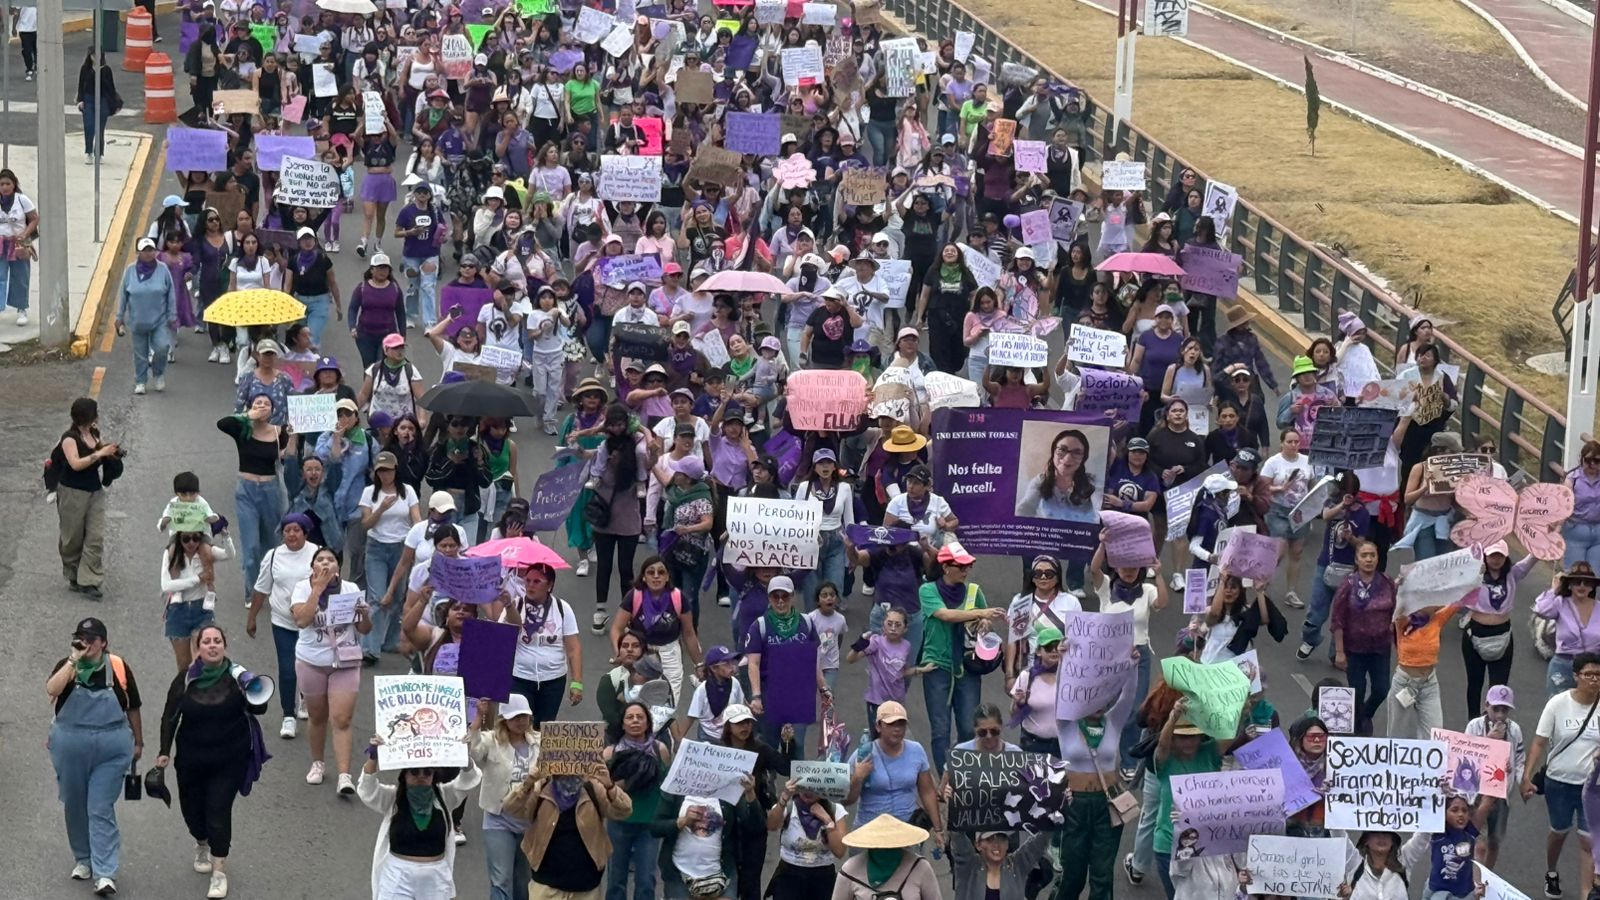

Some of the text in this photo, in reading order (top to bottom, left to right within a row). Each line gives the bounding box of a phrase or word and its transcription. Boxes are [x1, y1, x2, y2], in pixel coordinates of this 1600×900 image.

[952, 431, 987, 440] ESTAMOS
[948, 462, 1002, 476] Nos falta
[733, 502, 748, 514] NI
[731, 521, 814, 543] NI OLVIDO!!
[730, 539, 798, 553] NOS FALTA
[736, 550, 813, 568] ARACELI
[378, 692, 461, 713] ME DIJO LUCHA
[544, 724, 599, 738] NO SOMOS
[951, 751, 1046, 770] SOY MUJER
[955, 770, 1020, 789] DE ALAS
[953, 788, 998, 808] NO DE
[953, 808, 1002, 828] JAULAS
[1353, 807, 1420, 830] trabajo!
[1264, 882, 1285, 894] NO
